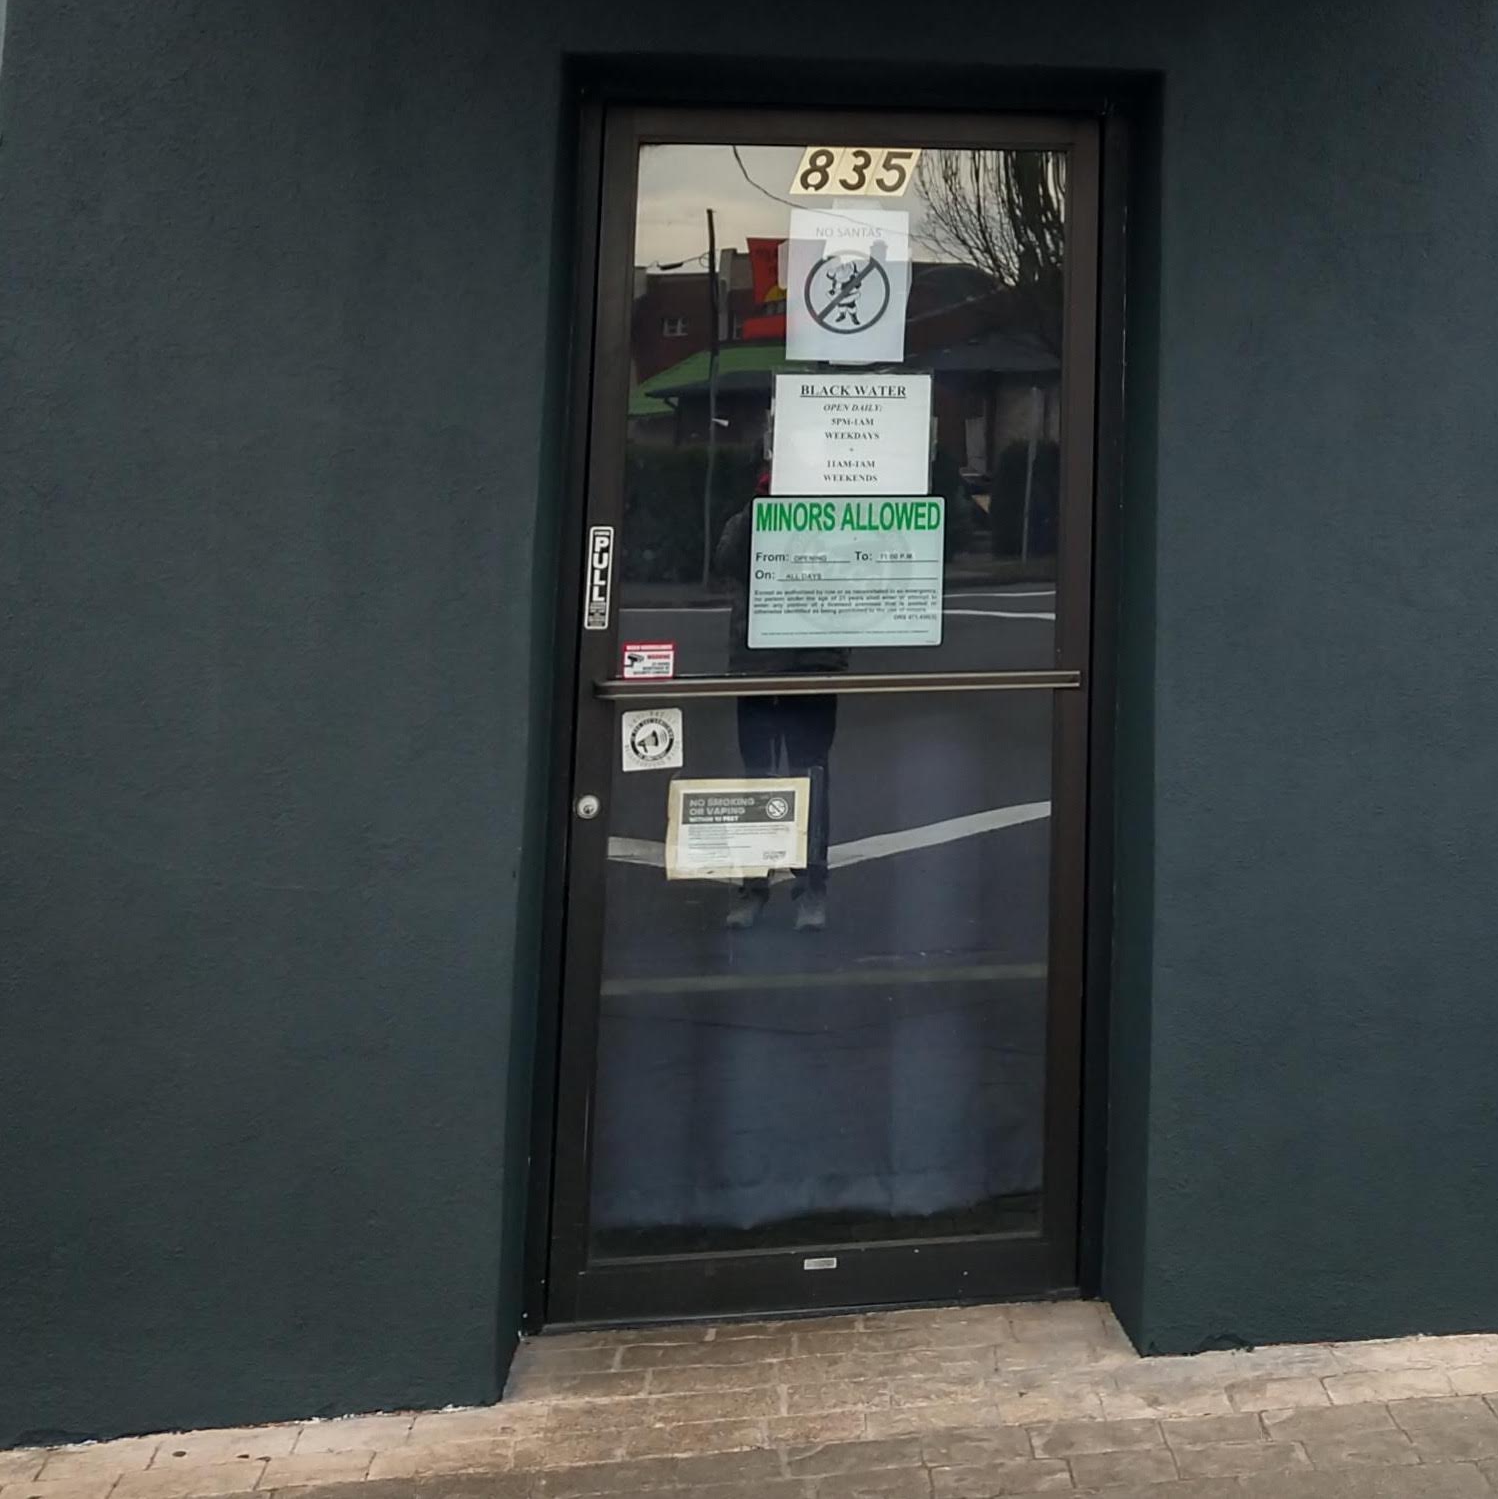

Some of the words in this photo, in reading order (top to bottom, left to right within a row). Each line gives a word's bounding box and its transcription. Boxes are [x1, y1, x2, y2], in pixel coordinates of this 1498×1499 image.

[800, 149, 913, 192] 835
[816, 227, 834, 238] NO
[838, 227, 882, 239] SANTAS
[801, 385, 850, 396] BLACK
[855, 386, 906, 397] WATER
[823, 404, 849, 412] OPEN
[824, 432, 880, 440] WEEKDAYS
[823, 474, 878, 482] WEEKENDS
[756, 502, 836, 531] MINORS
[840, 502, 941, 531] ALLOWED
[755, 552, 789, 562] From:
[854, 551, 873, 561] To:
[592, 536, 609, 601] PULL
[755, 570, 776, 580] On:
[690, 799, 705, 807] NO
[707, 797, 755, 806] SMOKING
[706, 807, 746, 816] VAPING
